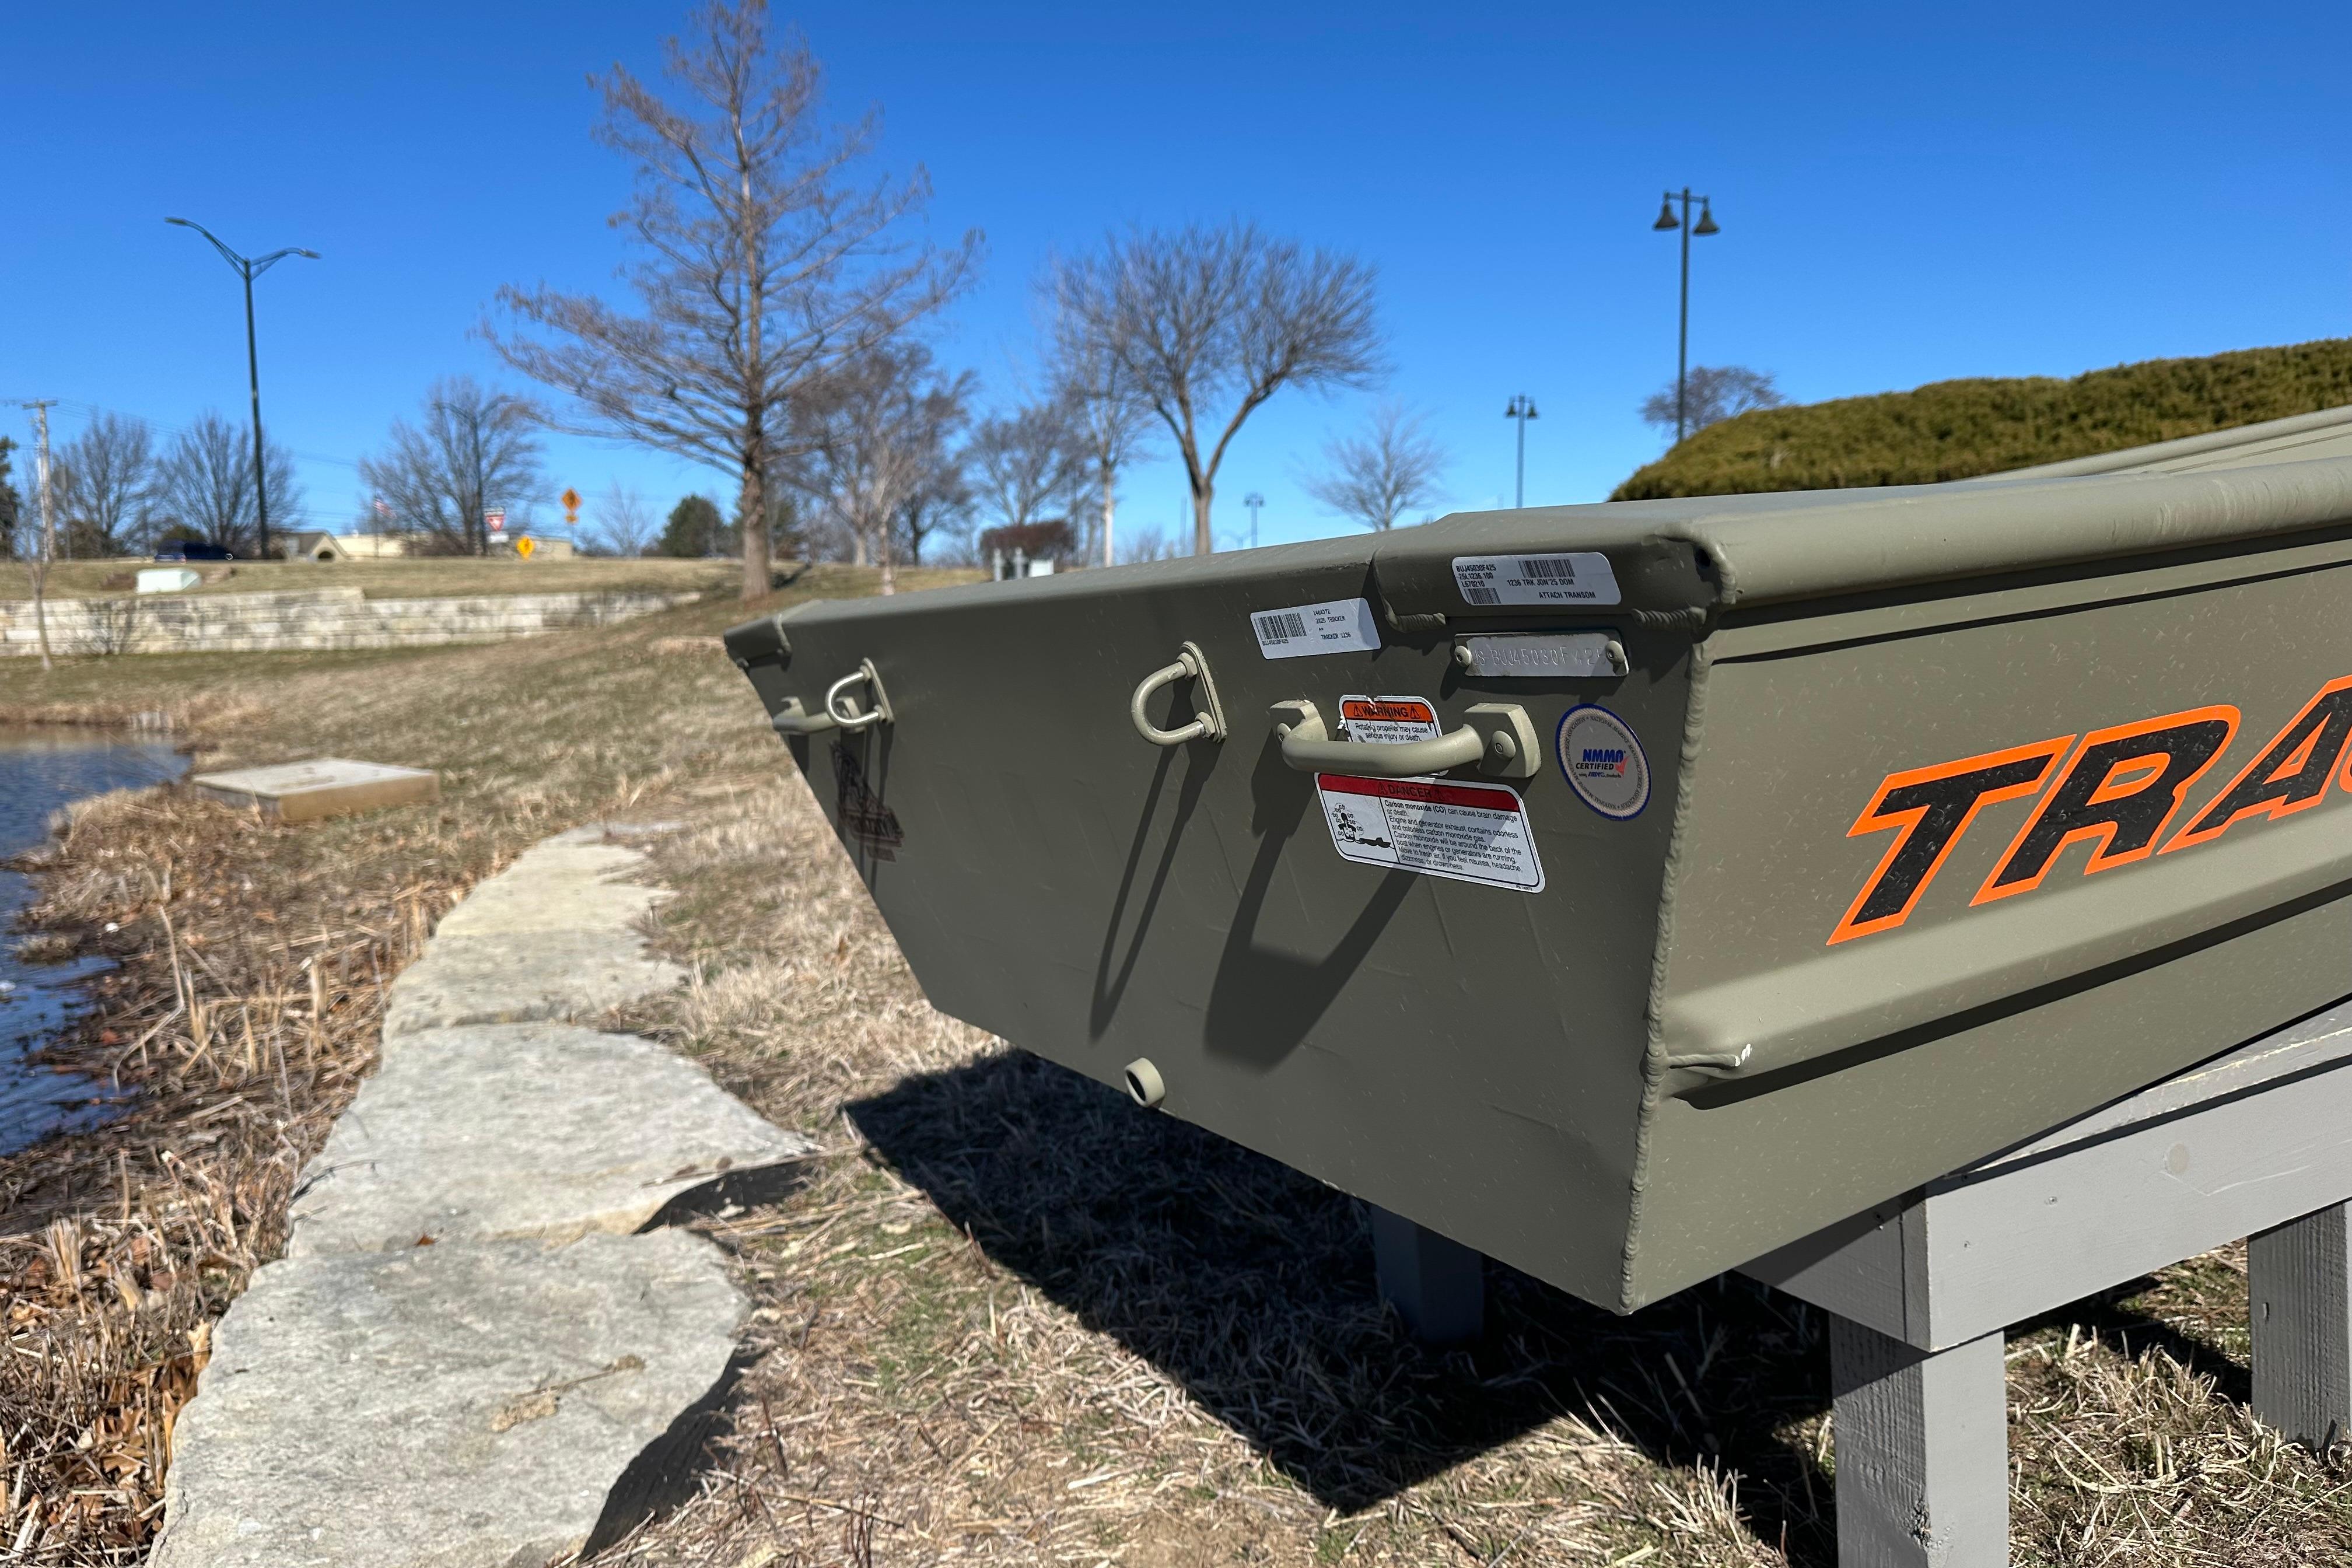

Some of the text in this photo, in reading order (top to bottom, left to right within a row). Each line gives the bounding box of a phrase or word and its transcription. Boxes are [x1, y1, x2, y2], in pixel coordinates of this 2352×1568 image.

[1362, 705, 1409, 718] WARNING
[1354, 723, 1376, 733] Rotating
[1376, 724, 1398, 733] propeller
[1384, 732, 1398, 741] injury
[1388, 784, 1432, 798] DANGER
[1384, 800, 1405, 809] Carbon
[1405, 804, 1432, 812] monoxide
[1433, 806, 1446, 815] (CO)
[1477, 810, 1492, 818] brain
[1493, 813, 1517, 823] damage
[1826, 674, 2351, 946] TRA
[1388, 816, 1407, 824] Engine
[1418, 820, 1444, 829] generator
[1444, 823, 1466, 832] exhaust
[1468, 827, 1492, 835] contains
[1492, 829, 1518, 838] odorless
[1402, 825, 1425, 834] colorless
[1446, 832, 1473, 841] monoxide
[1394, 831, 1412, 839] Carbon
[1413, 835, 1439, 844] monoxide
[1458, 841, 1478, 849] around
[1398, 846, 1412, 854] Move
[1419, 849, 1432, 858] fresh
[1458, 855, 1468, 863] feel
[1423, 844, 1444, 852] engines
[1452, 848, 1482, 858] generators
